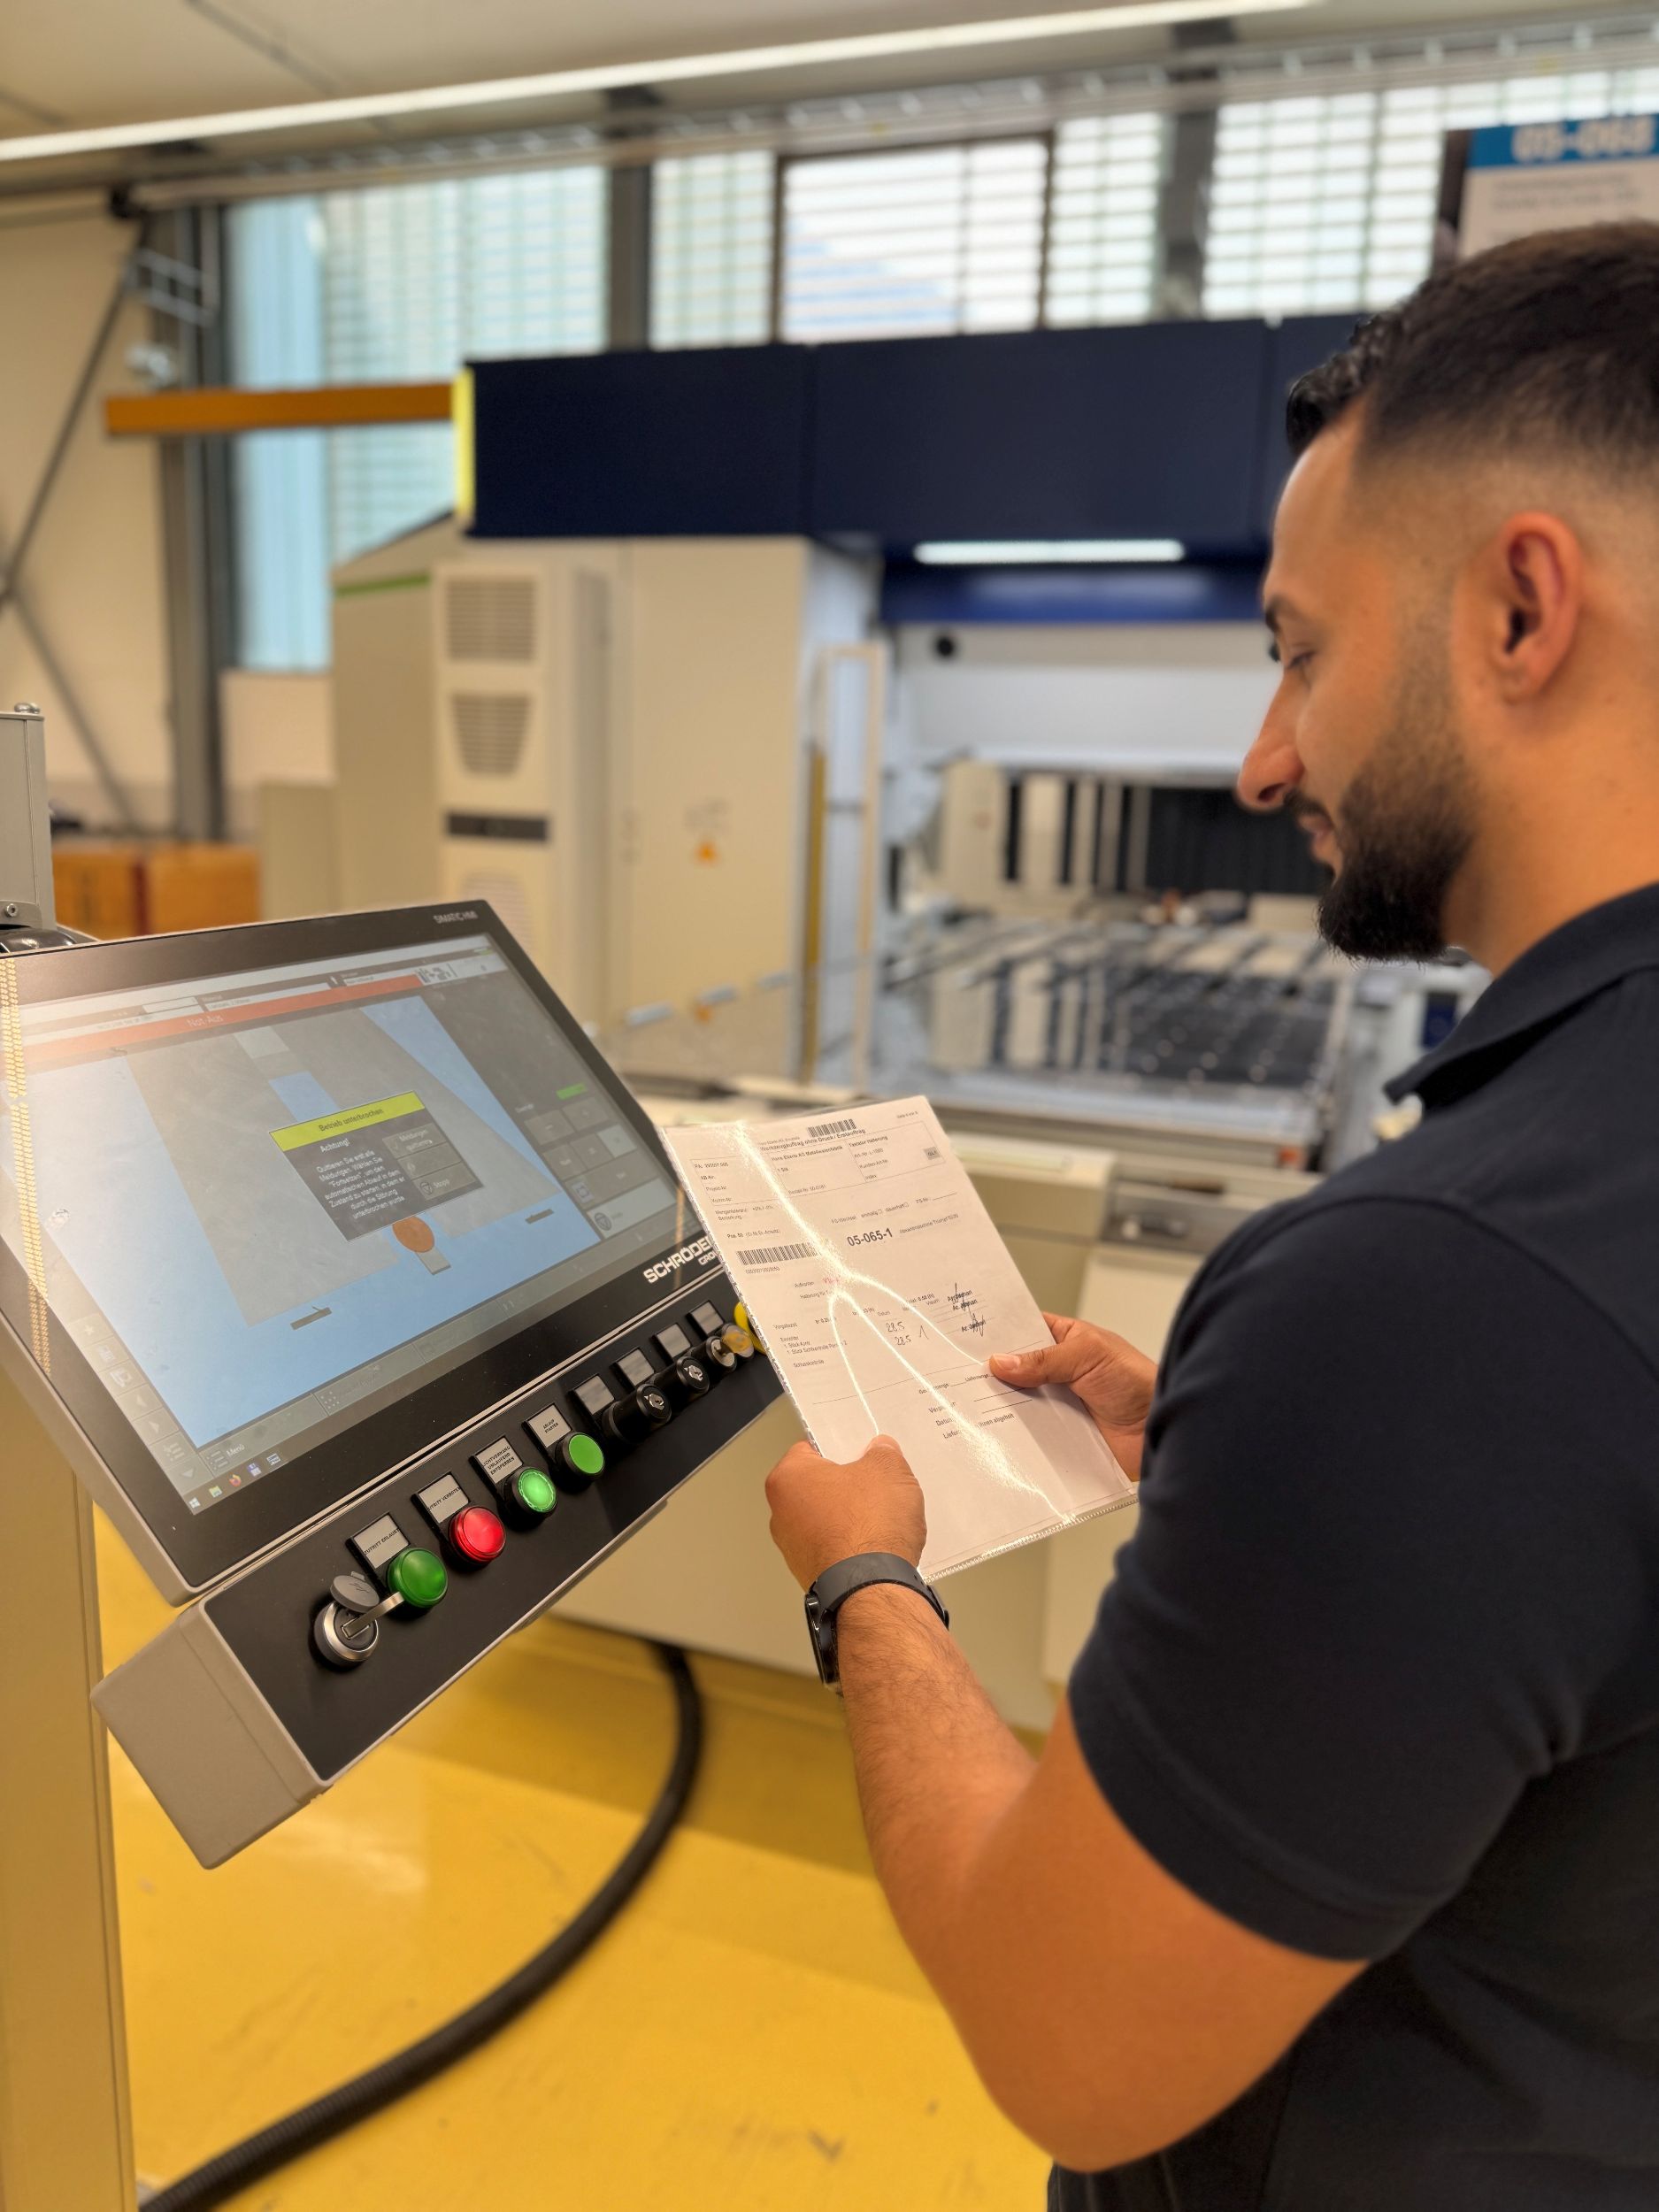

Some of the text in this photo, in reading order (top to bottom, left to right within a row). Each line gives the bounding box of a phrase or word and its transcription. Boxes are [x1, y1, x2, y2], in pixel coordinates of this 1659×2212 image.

[319, 1138, 350, 1152] Achtung!
[847, 1227, 894, 1247] 05-065-1
[643, 1235, 713, 1284] SCHRÖDE
[698, 1249, 718, 1265] GRO
[544, 1423, 559, 1433] STARTEN
[226, 1444, 245, 1457] Menü
[490, 1456, 515, 1475] ENTSPERREN
